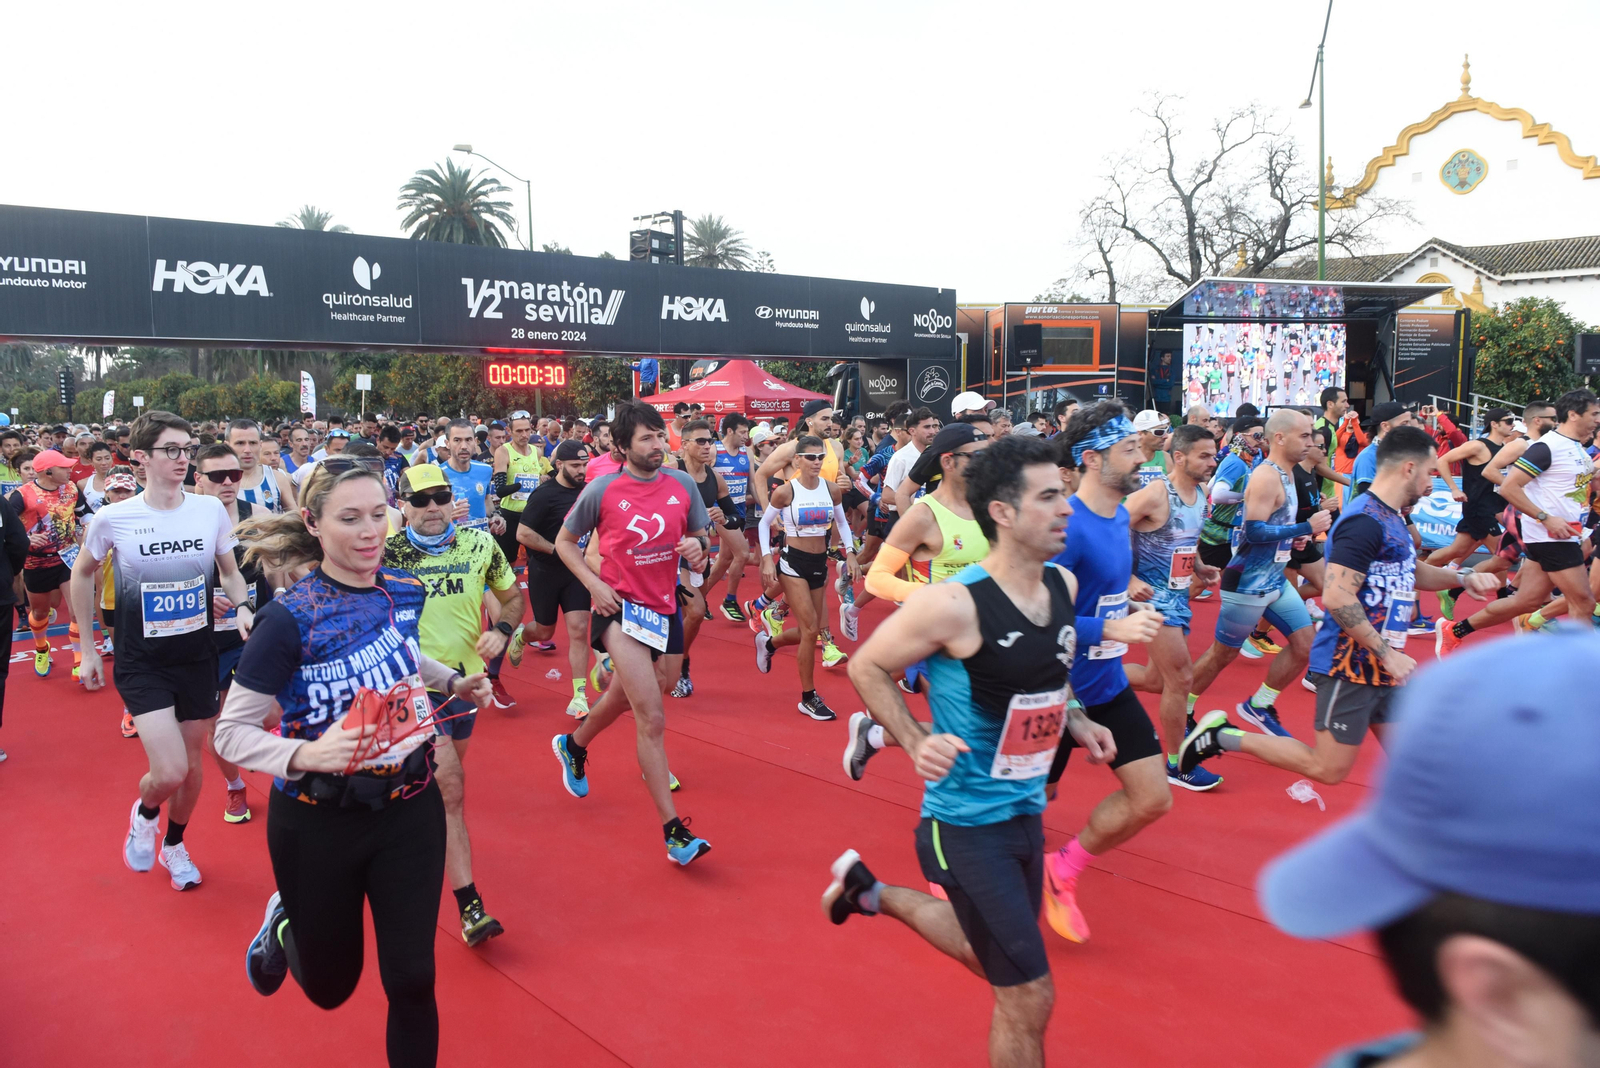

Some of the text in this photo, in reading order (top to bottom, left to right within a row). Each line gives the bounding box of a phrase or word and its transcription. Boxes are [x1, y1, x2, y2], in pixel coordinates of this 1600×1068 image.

[52, 278, 87, 289] Motor
[153, 259, 269, 296] HOKA
[494, 280, 602, 305] maratón
[330, 311, 406, 323] Healthcare Partner
[525, 298, 604, 324] sevilla
[660, 295, 727, 322] HOKA
[775, 308, 820, 320] HYUNDAI
[1025, 306, 1058, 314] portos
[511, 328, 587, 342] 28 enero 2024
[489, 364, 566, 385] 00:00:30
[804, 510, 826, 520] 1940
[139, 539, 204, 556] LEPAPE
[153, 593, 196, 612] 2019
[631, 603, 659, 625] 3106
[301, 625, 403, 682] MEDIO MARATÓN
